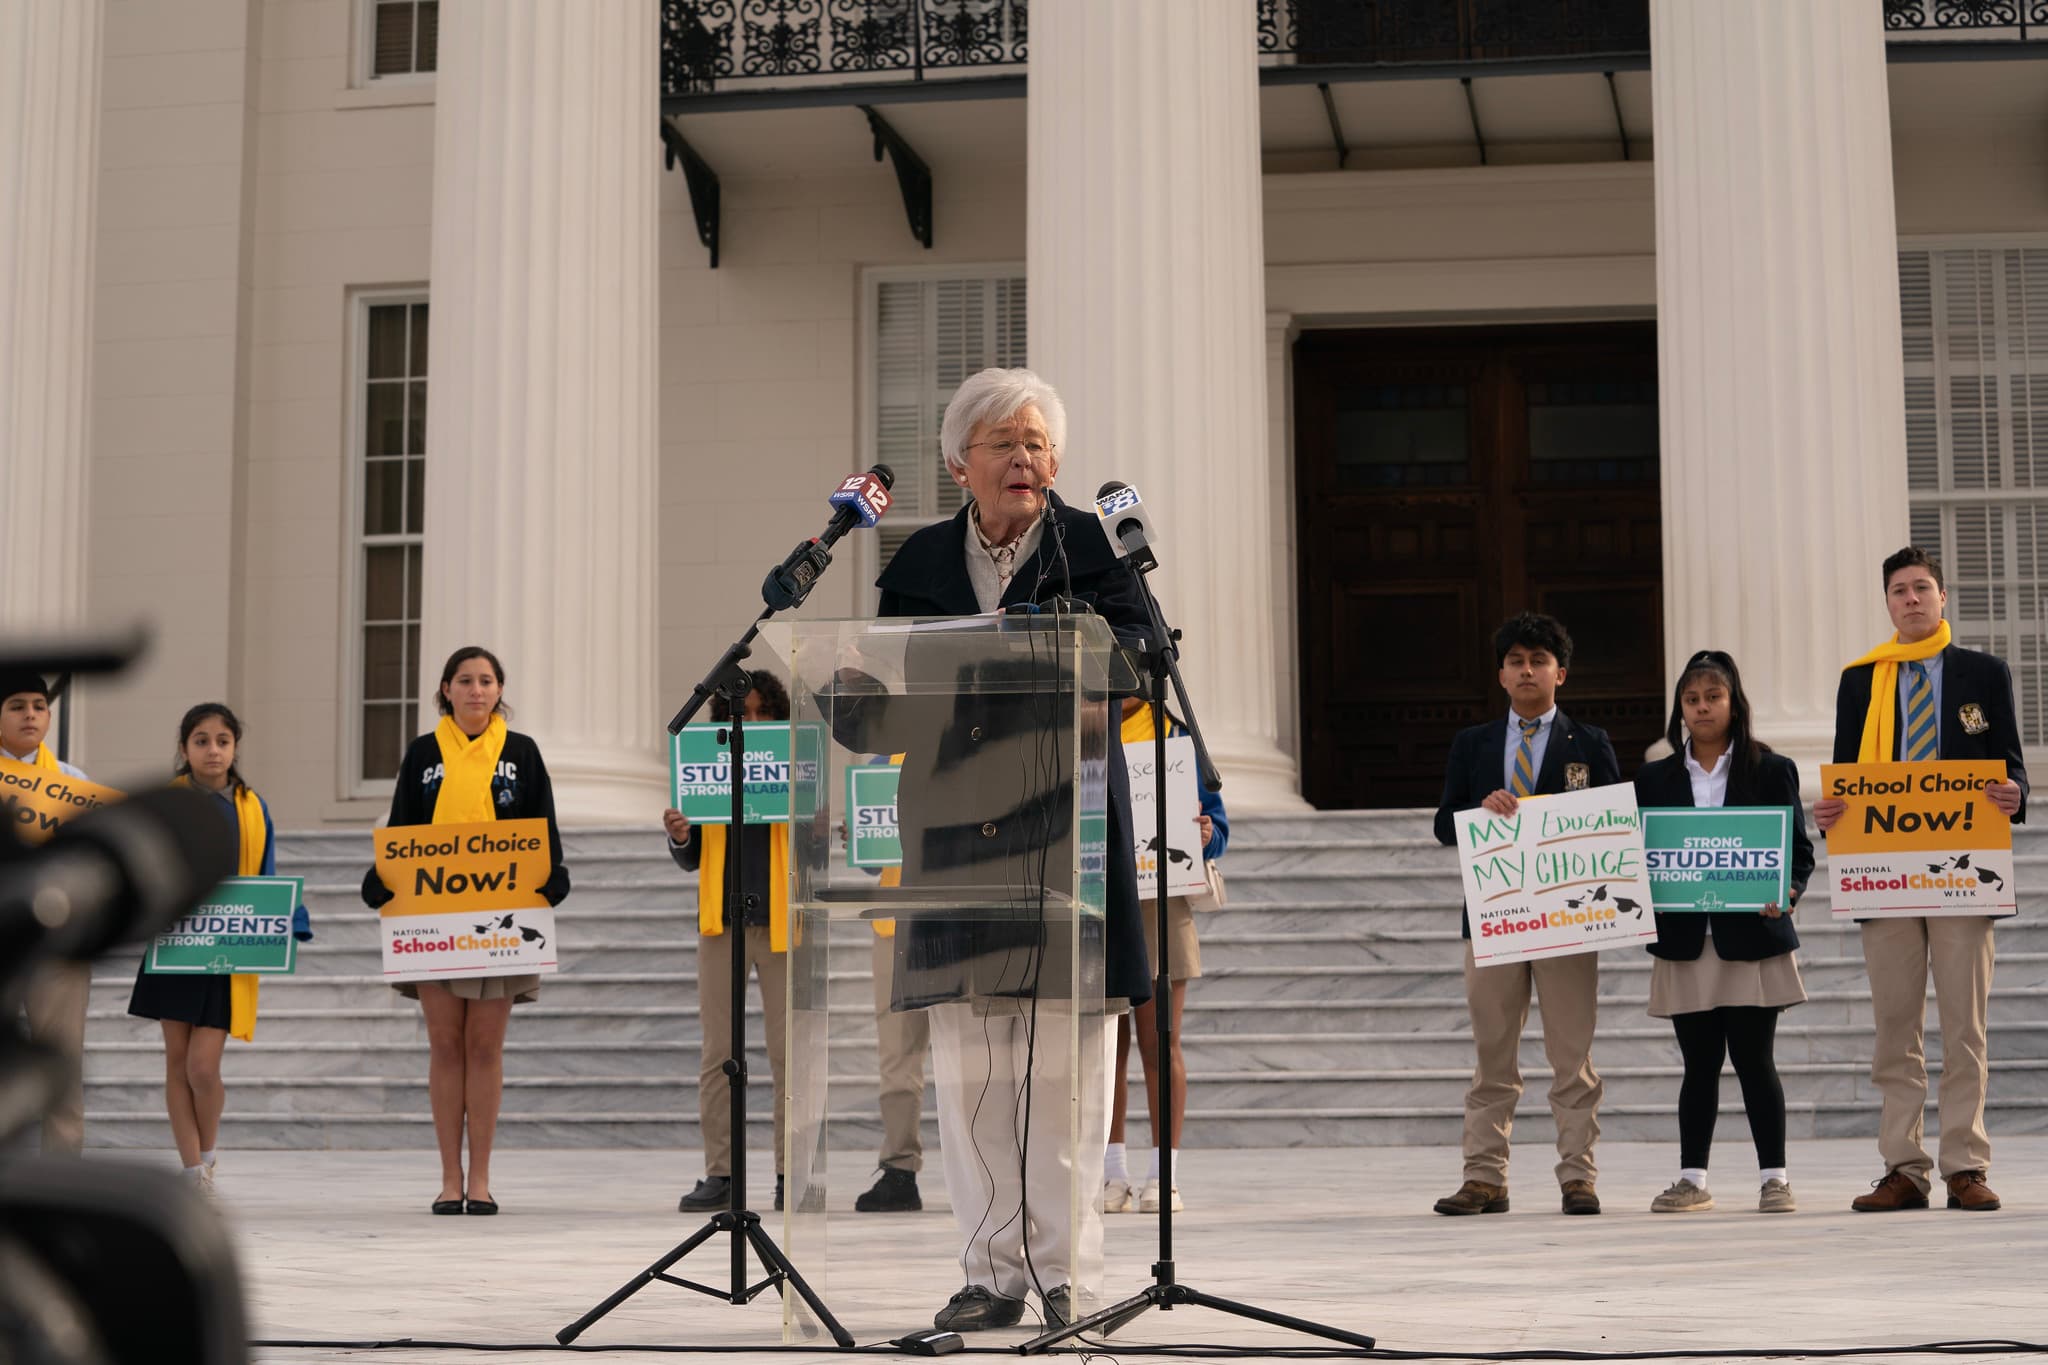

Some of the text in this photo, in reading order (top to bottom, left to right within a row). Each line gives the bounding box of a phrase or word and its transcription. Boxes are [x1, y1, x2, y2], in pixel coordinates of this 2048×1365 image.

[842, 476, 867, 490] 12
[865, 482, 888, 513] 12
[1096, 488, 1132, 505] WAKA
[857, 495, 876, 522] WSFA
[717, 751, 774, 762] STONG
[680, 784, 790, 796] STRON ALABA
[1832, 774, 1912, 796] School
[45, 783, 104, 809] Choi
[1864, 802, 1974, 834] Now!
[1468, 813, 1521, 848] MY
[385, 833, 540, 860] School Choice
[1683, 837, 1743, 848] STRONG
[1646, 851, 1779, 868] STUDENTS
[1472, 848, 1640, 891] MY CHOICE
[1706, 871, 1779, 881] ALABAMA
[1841, 866, 1892, 875] NATIONAL
[415, 862, 517, 896] Now!
[198, 904, 254, 915] STRONG
[1481, 906, 1531, 919] NATIONAL
[393, 928, 440, 936] NATIONAL
[1584, 922, 1617, 932] WEEK
[158, 936, 287, 946] STRONG ALABAMA
[489, 950, 520, 958] WEEK
